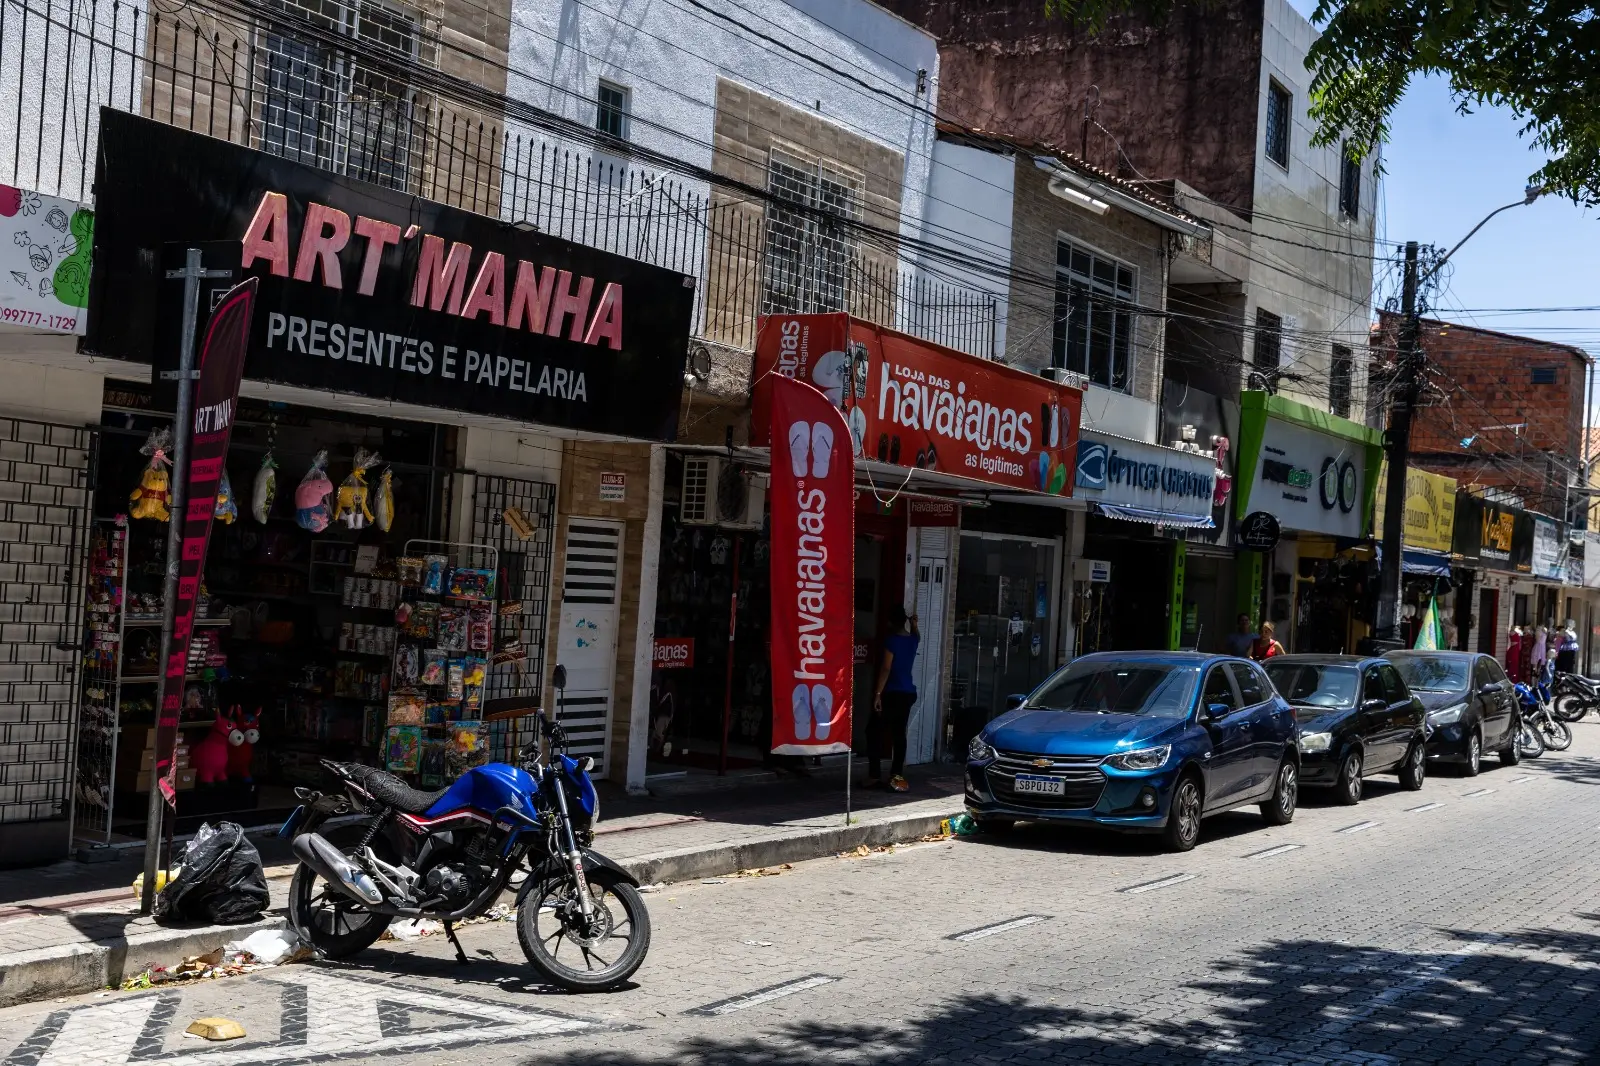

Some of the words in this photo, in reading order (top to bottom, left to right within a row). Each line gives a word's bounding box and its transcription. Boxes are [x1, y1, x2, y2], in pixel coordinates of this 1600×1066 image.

[267, 311, 434, 376] PRESENTES
[441, 345, 457, 379] E
[463, 351, 588, 403] PAPELARIA
[894, 363, 925, 383] LOJA
[928, 374, 951, 390] DAS
[878, 361, 1033, 456] havaianas
[964, 453, 978, 468] as
[979, 452, 1024, 477] legítimas
[911, 501, 954, 514] havaianas
[653, 641, 689, 662] ianas
